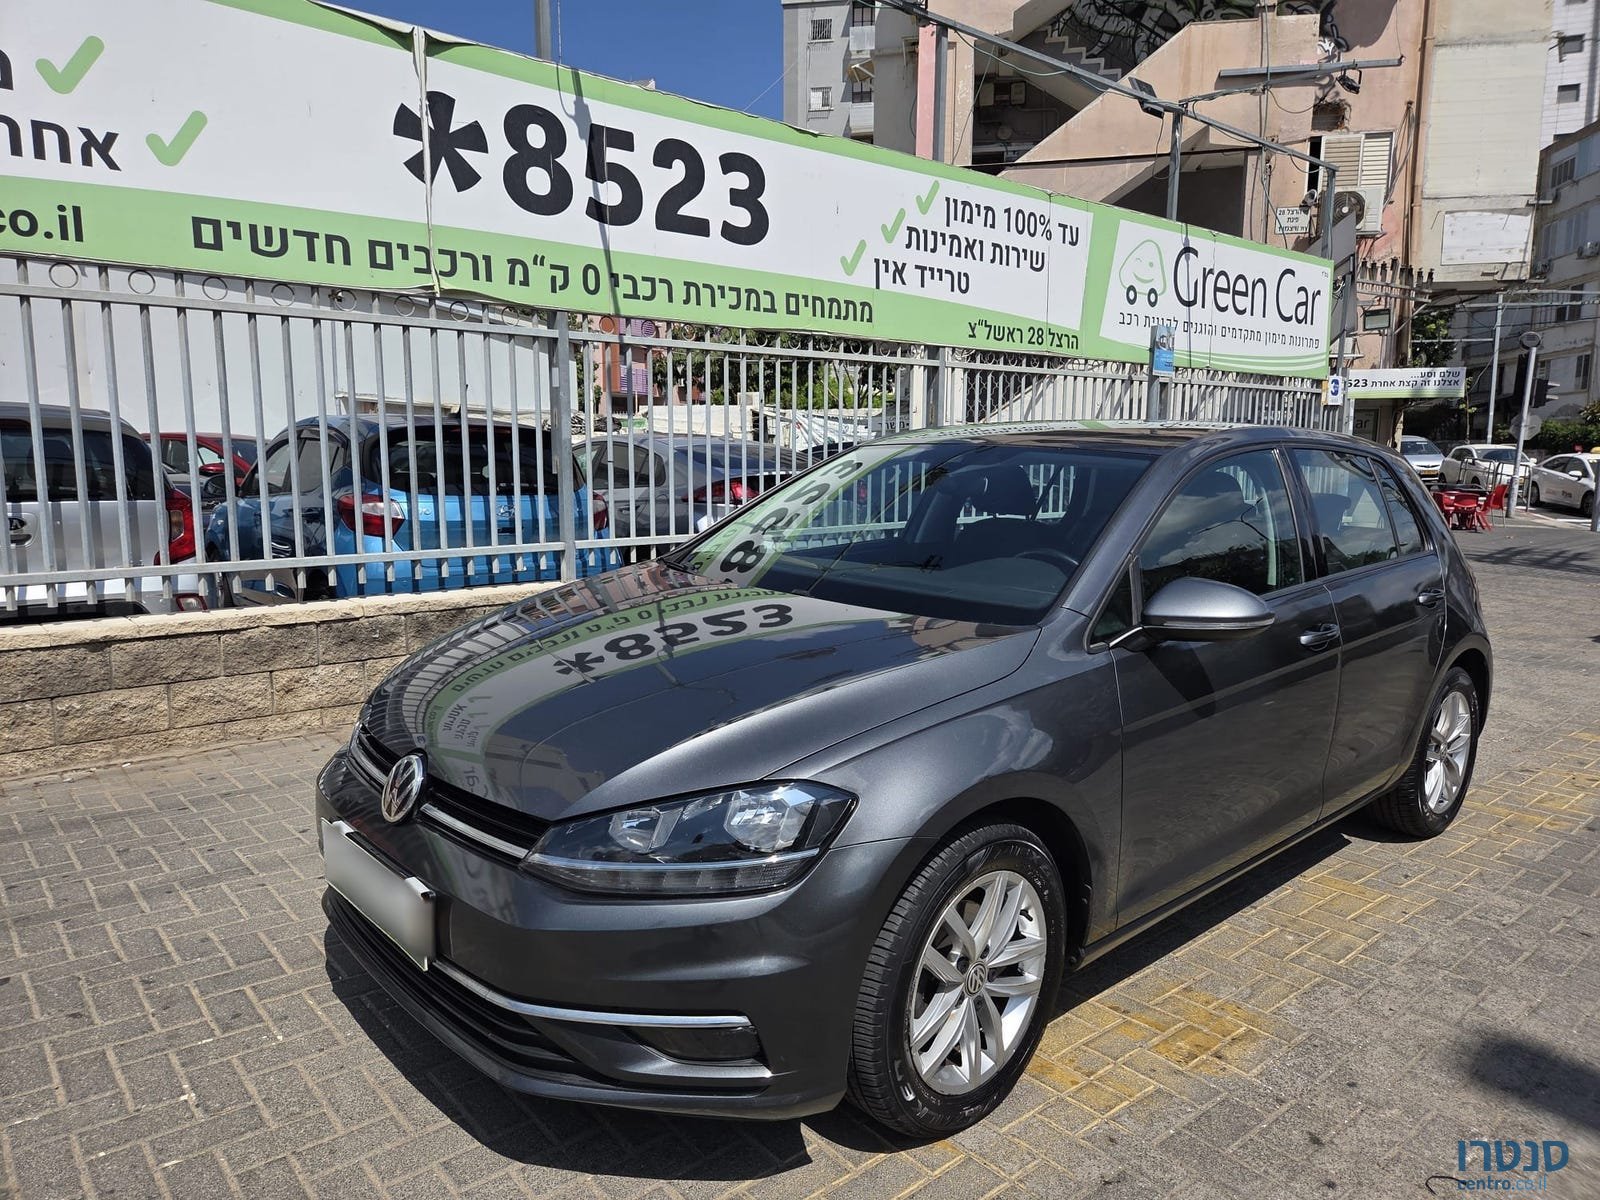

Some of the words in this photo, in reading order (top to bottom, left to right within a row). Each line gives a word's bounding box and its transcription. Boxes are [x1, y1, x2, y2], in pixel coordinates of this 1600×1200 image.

[945, 196, 996, 229] מימון
[1004, 207, 1052, 241] 100%
[191, 215, 352, 266] חדשים
[905, 225, 983, 262] ואמינות
[1058, 223, 1079, 246] עד
[368, 239, 493, 283] ורכבים
[990, 241, 1045, 273] שירות
[581, 263, 600, 295] 0
[612, 272, 673, 303] רכבי
[874, 258, 907, 289] אין
[914, 264, 970, 294] טרייד
[1173, 246, 1267, 319] Green
[1275, 268, 1321, 325] Car
[683, 281, 777, 314] במכירת
[786, 293, 873, 324] מתמחים
[1118, 312, 1139, 326] רכב
[1221, 325, 1262, 343] מתקדמים
[1027, 327, 1044, 346] 28
[1048, 330, 1079, 350] הרצל
[1265, 331, 1286, 347] מימון
[1289, 335, 1320, 350] פתרונות
[1398, 379, 1418, 389] קצת
[1434, 379, 1460, 387] אצלנו
[1439, 369, 1460, 378] שלם
